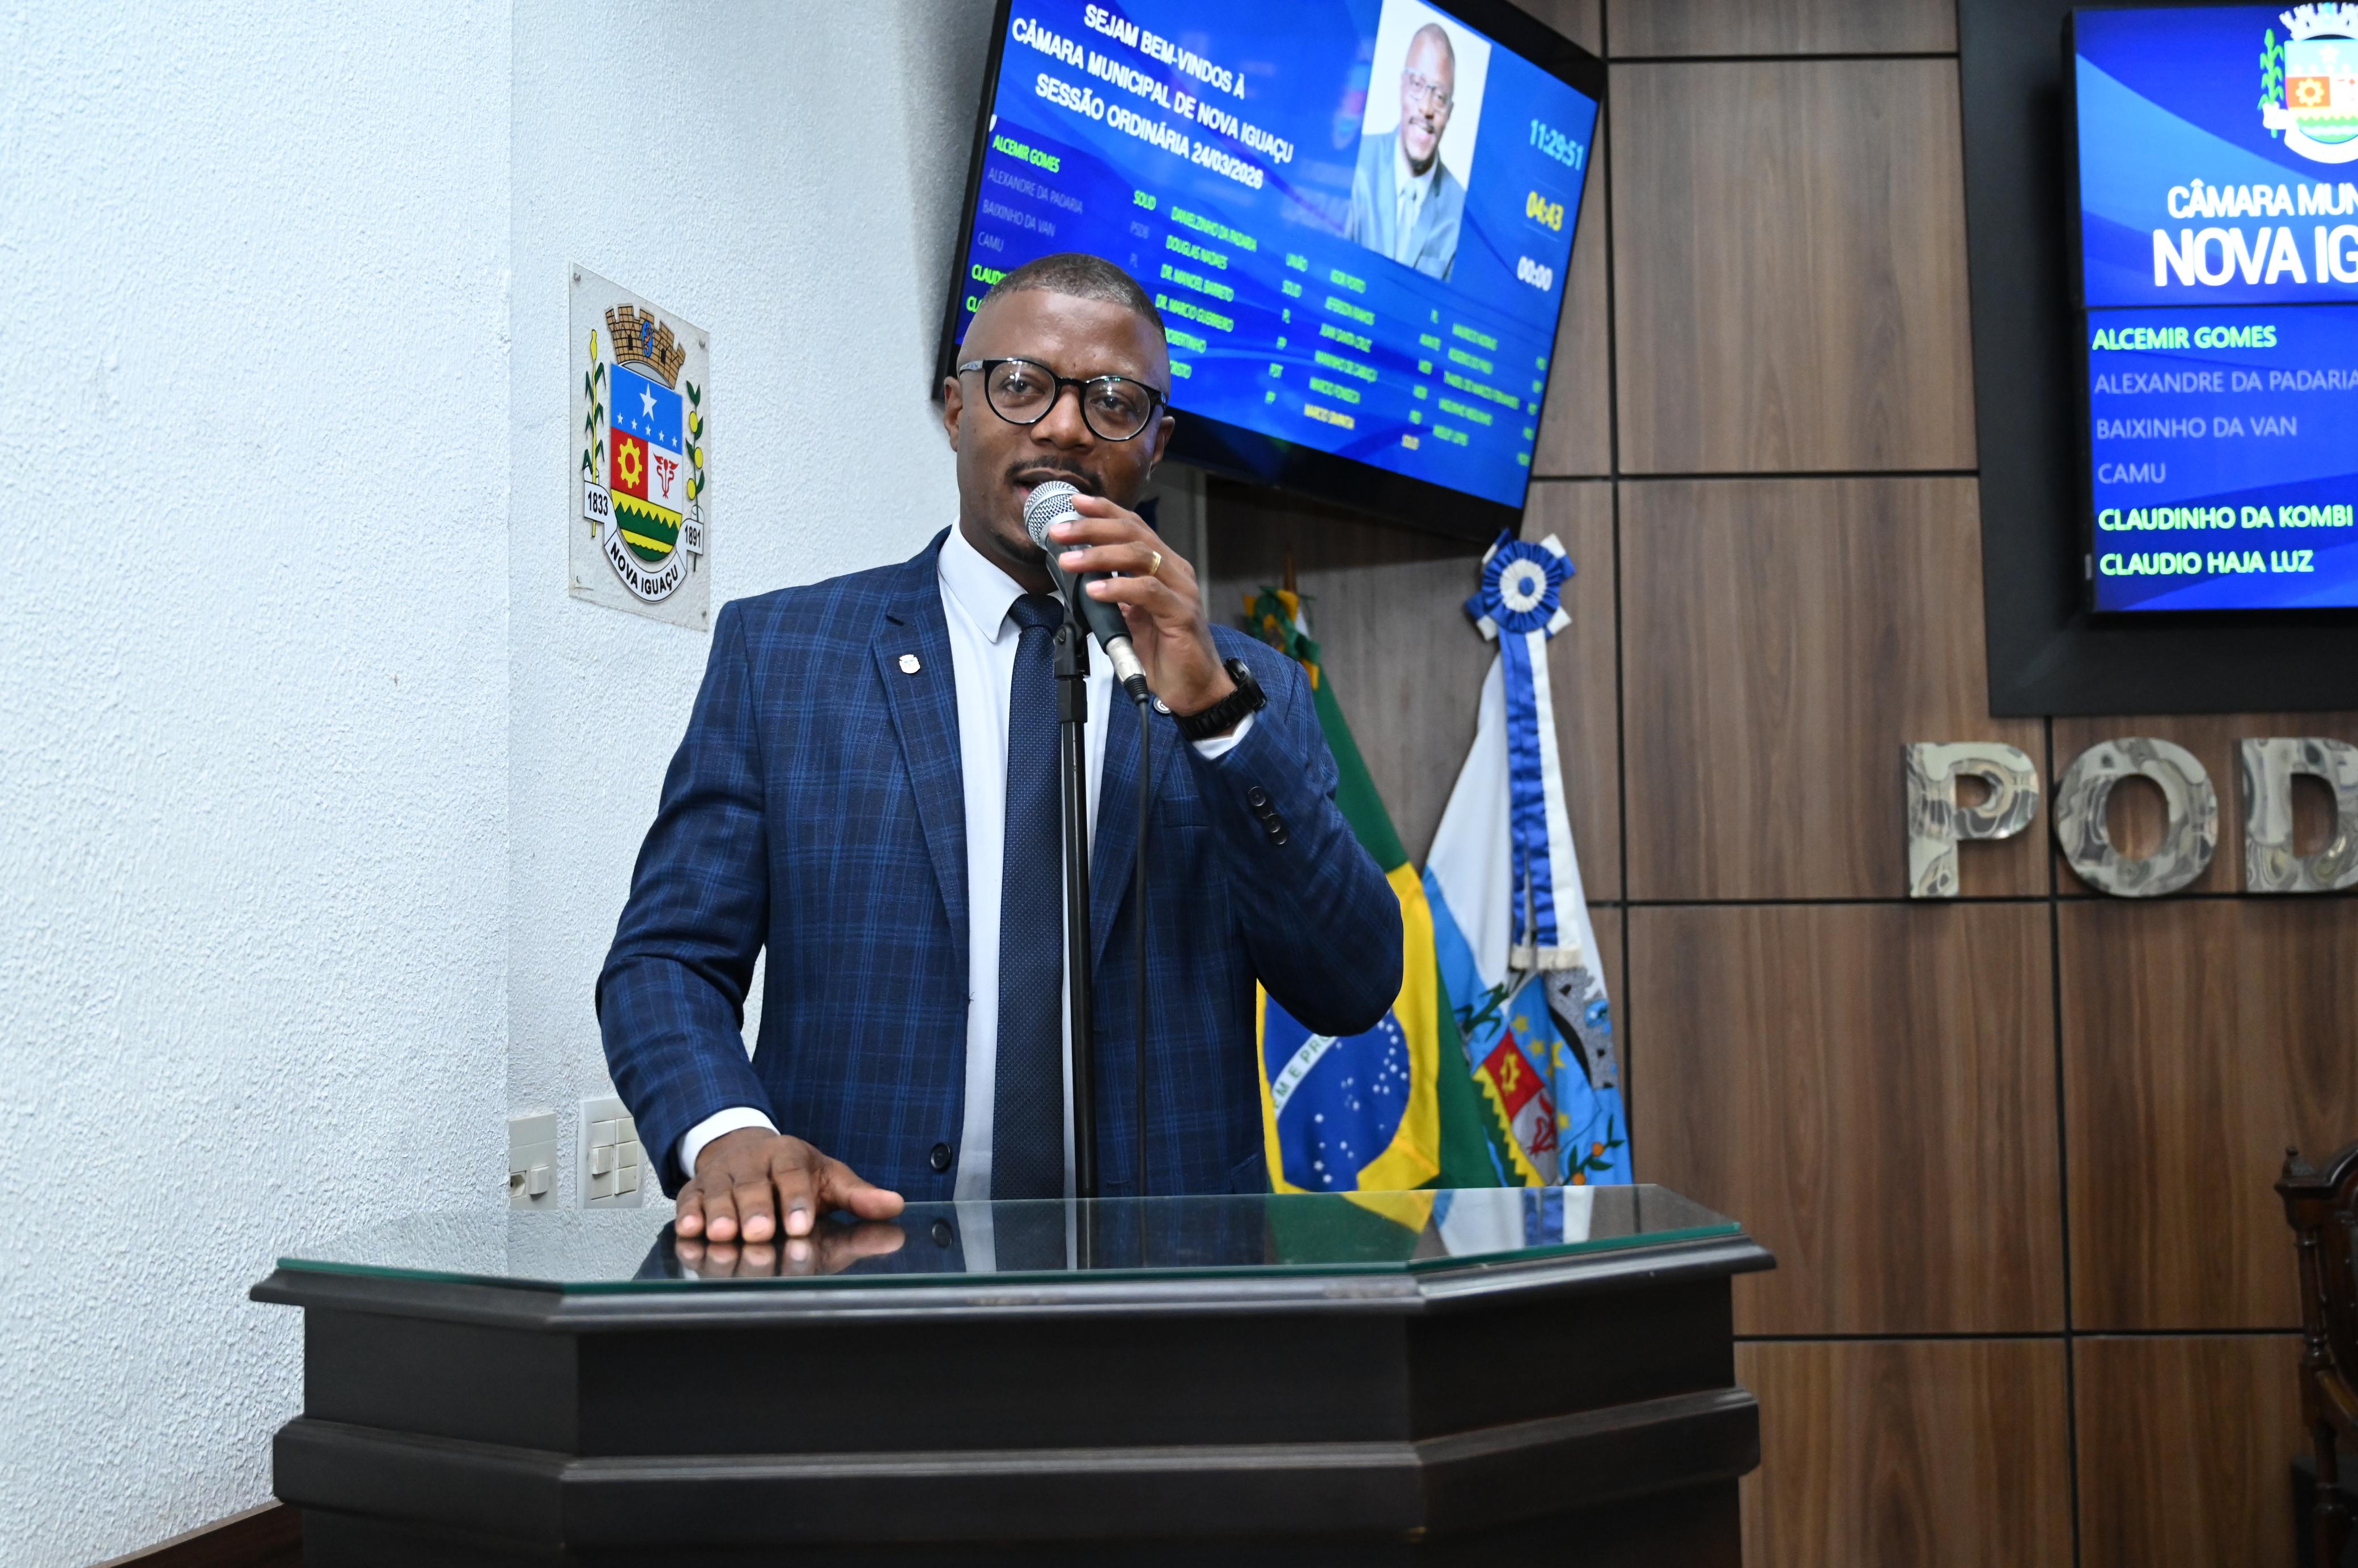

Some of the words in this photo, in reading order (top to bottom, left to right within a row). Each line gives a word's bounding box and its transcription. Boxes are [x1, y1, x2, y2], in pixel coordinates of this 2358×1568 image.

[1084, 3, 1139, 48] SEJAM
[1140, 31, 1233, 92] BEM-VINDOS
[1233, 74, 1245, 100] À
[1012, 18, 1084, 69] CÂMARA
[1088, 51, 1170, 109] MUNICIPAL
[1173, 91, 1195, 120] DE
[1197, 102, 1239, 139] NOVA
[1241, 122, 1293, 164] IGUAÇU
[1036, 73, 1104, 121] SESSÃO
[1106, 105, 1189, 158] ORDINÁRIA
[1191, 142, 1263, 189] 24/03/2026
[993, 134, 1029, 162] ALCEMIR
[1029, 149, 1061, 173] GOMES
[987, 167, 1036, 197] ALEXANDRE
[1037, 185, 1048, 201] DA
[2168, 178, 2295, 219] CÂMARA
[982, 199, 1023, 226] BAIXINHO
[1024, 215, 1036, 231] DA
[1526, 190, 1564, 231] 04:43
[977, 232, 1004, 252] CAMU
[2153, 227, 2308, 287] NOVA
[972, 264, 1007, 285] CLAUD
[1517, 256, 1553, 292] 00:00
[2092, 327, 2190, 350] ALCEMIR
[2194, 325, 2278, 349] GOMES
[2094, 371, 2225, 394] ALEXANDRE
[2232, 370, 2262, 392] DA
[2269, 369, 2358, 391] PADARIA
[2096, 417, 2207, 440] BAIXINHO
[2213, 417, 2245, 437] DA
[2250, 416, 2297, 436] VAN
[2098, 462, 2166, 484] CAMU
[588, 491, 608, 516] 1833
[2098, 507, 2236, 530] CLAUDINHO
[2241, 505, 2274, 529] DA
[2279, 504, 2353, 528] KOMBI
[685, 525, 701, 549] 1891
[610, 542, 638, 589] NOVA
[641, 564, 678, 595] IGUAÇU
[2100, 552, 2202, 576] CLAUDIO
[2207, 551, 2267, 574] HAJA
[2271, 550, 2314, 572] LUZ
[1905, 737, 2358, 897] POD
